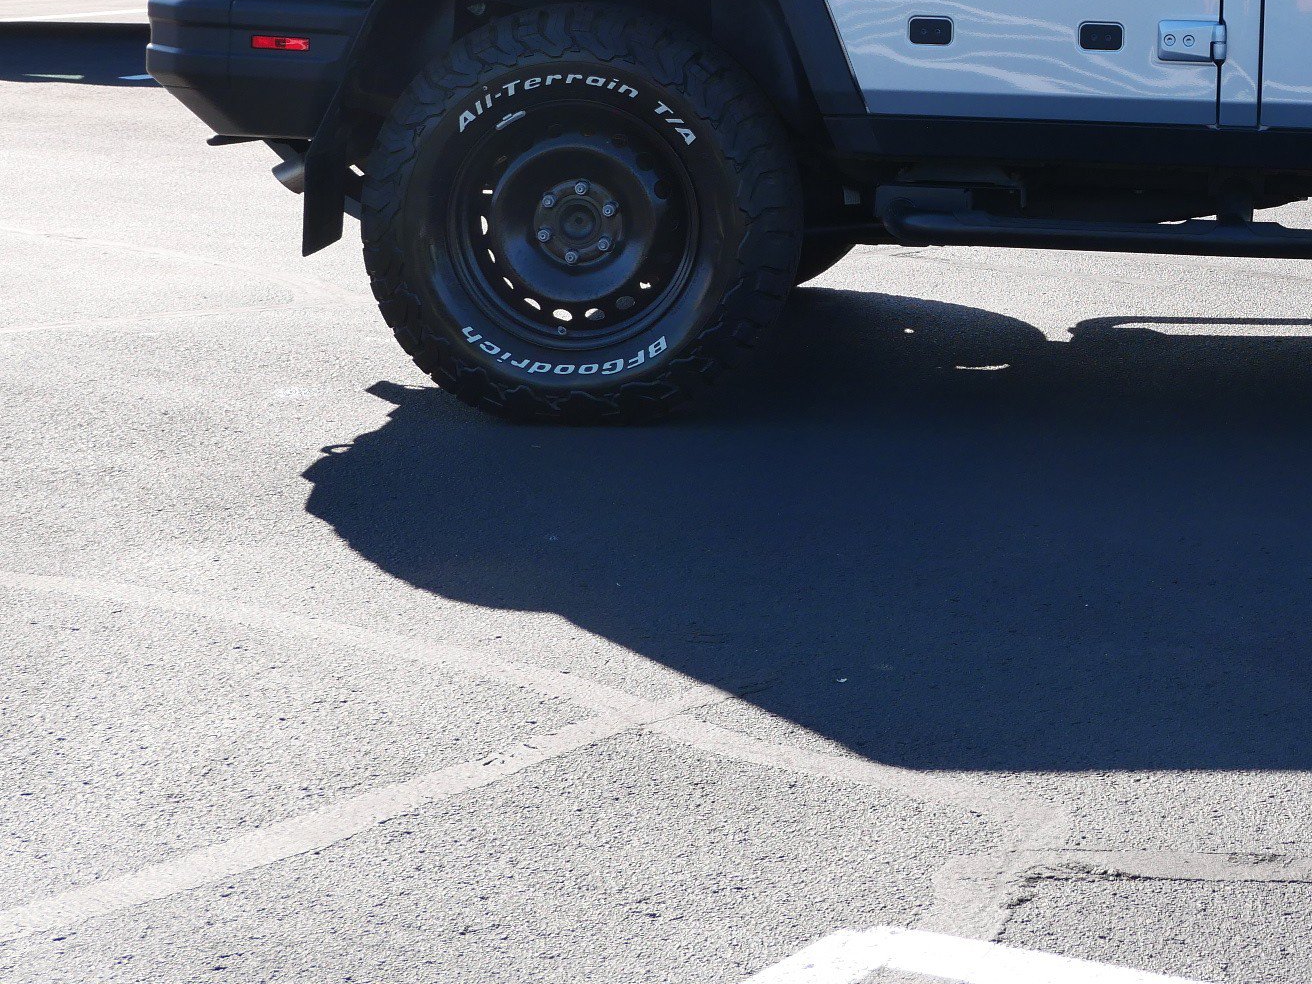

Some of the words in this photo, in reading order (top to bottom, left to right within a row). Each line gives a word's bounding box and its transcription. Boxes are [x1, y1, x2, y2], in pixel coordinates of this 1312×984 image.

[458, 73, 640, 133] All-Terrain
[654, 100, 697, 146] T/A
[462, 325, 669, 376] BFGoodrich
